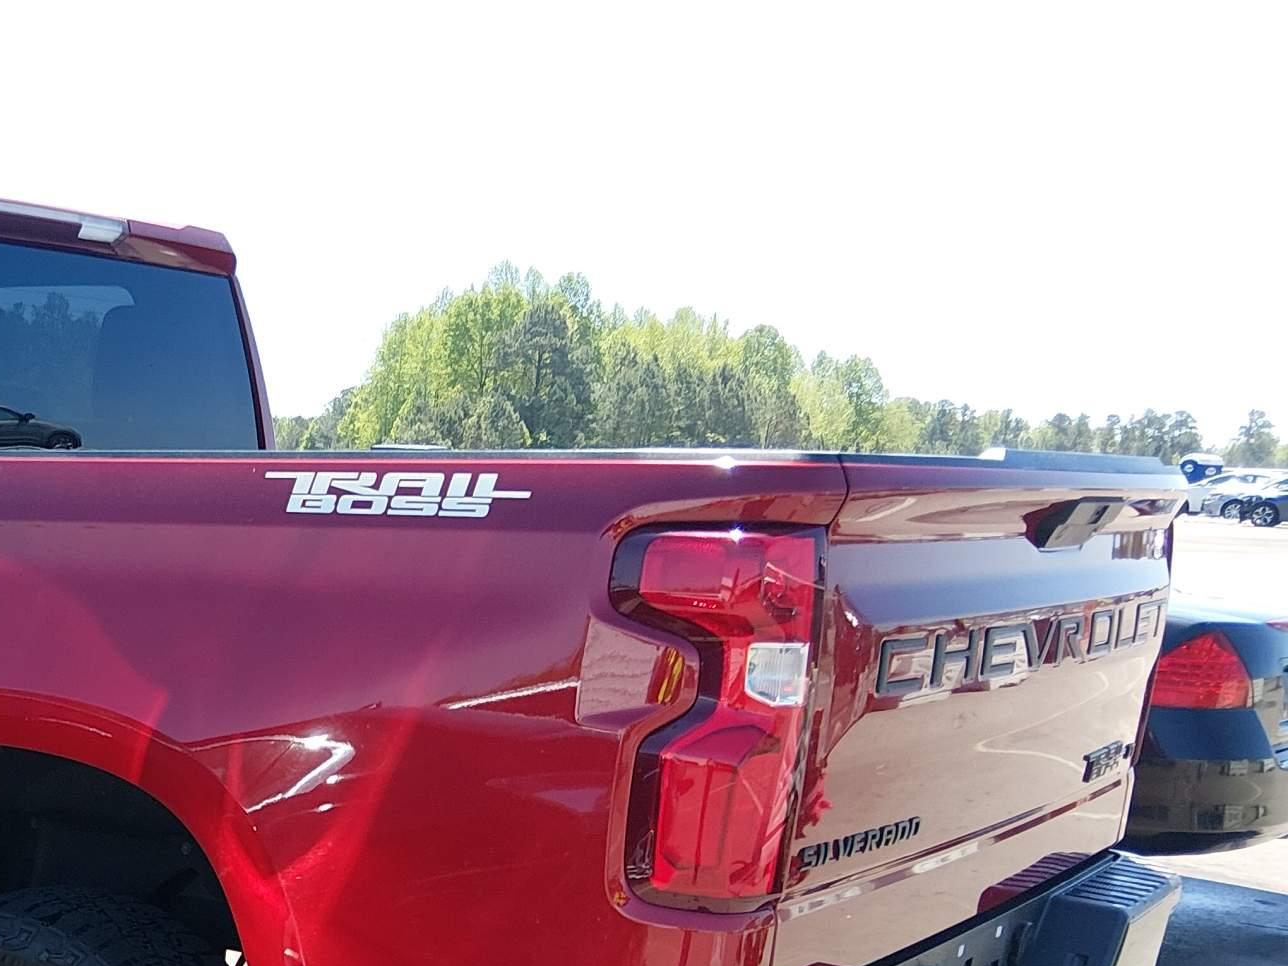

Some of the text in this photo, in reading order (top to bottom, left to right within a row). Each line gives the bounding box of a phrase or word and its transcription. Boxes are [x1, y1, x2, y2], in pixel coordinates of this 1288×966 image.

[265, 471, 532, 499] TRAIL
[286, 494, 493, 518] BOSS
[875, 598, 1168, 697] CHEVROLET
[797, 815, 921, 872] SILVERADO
